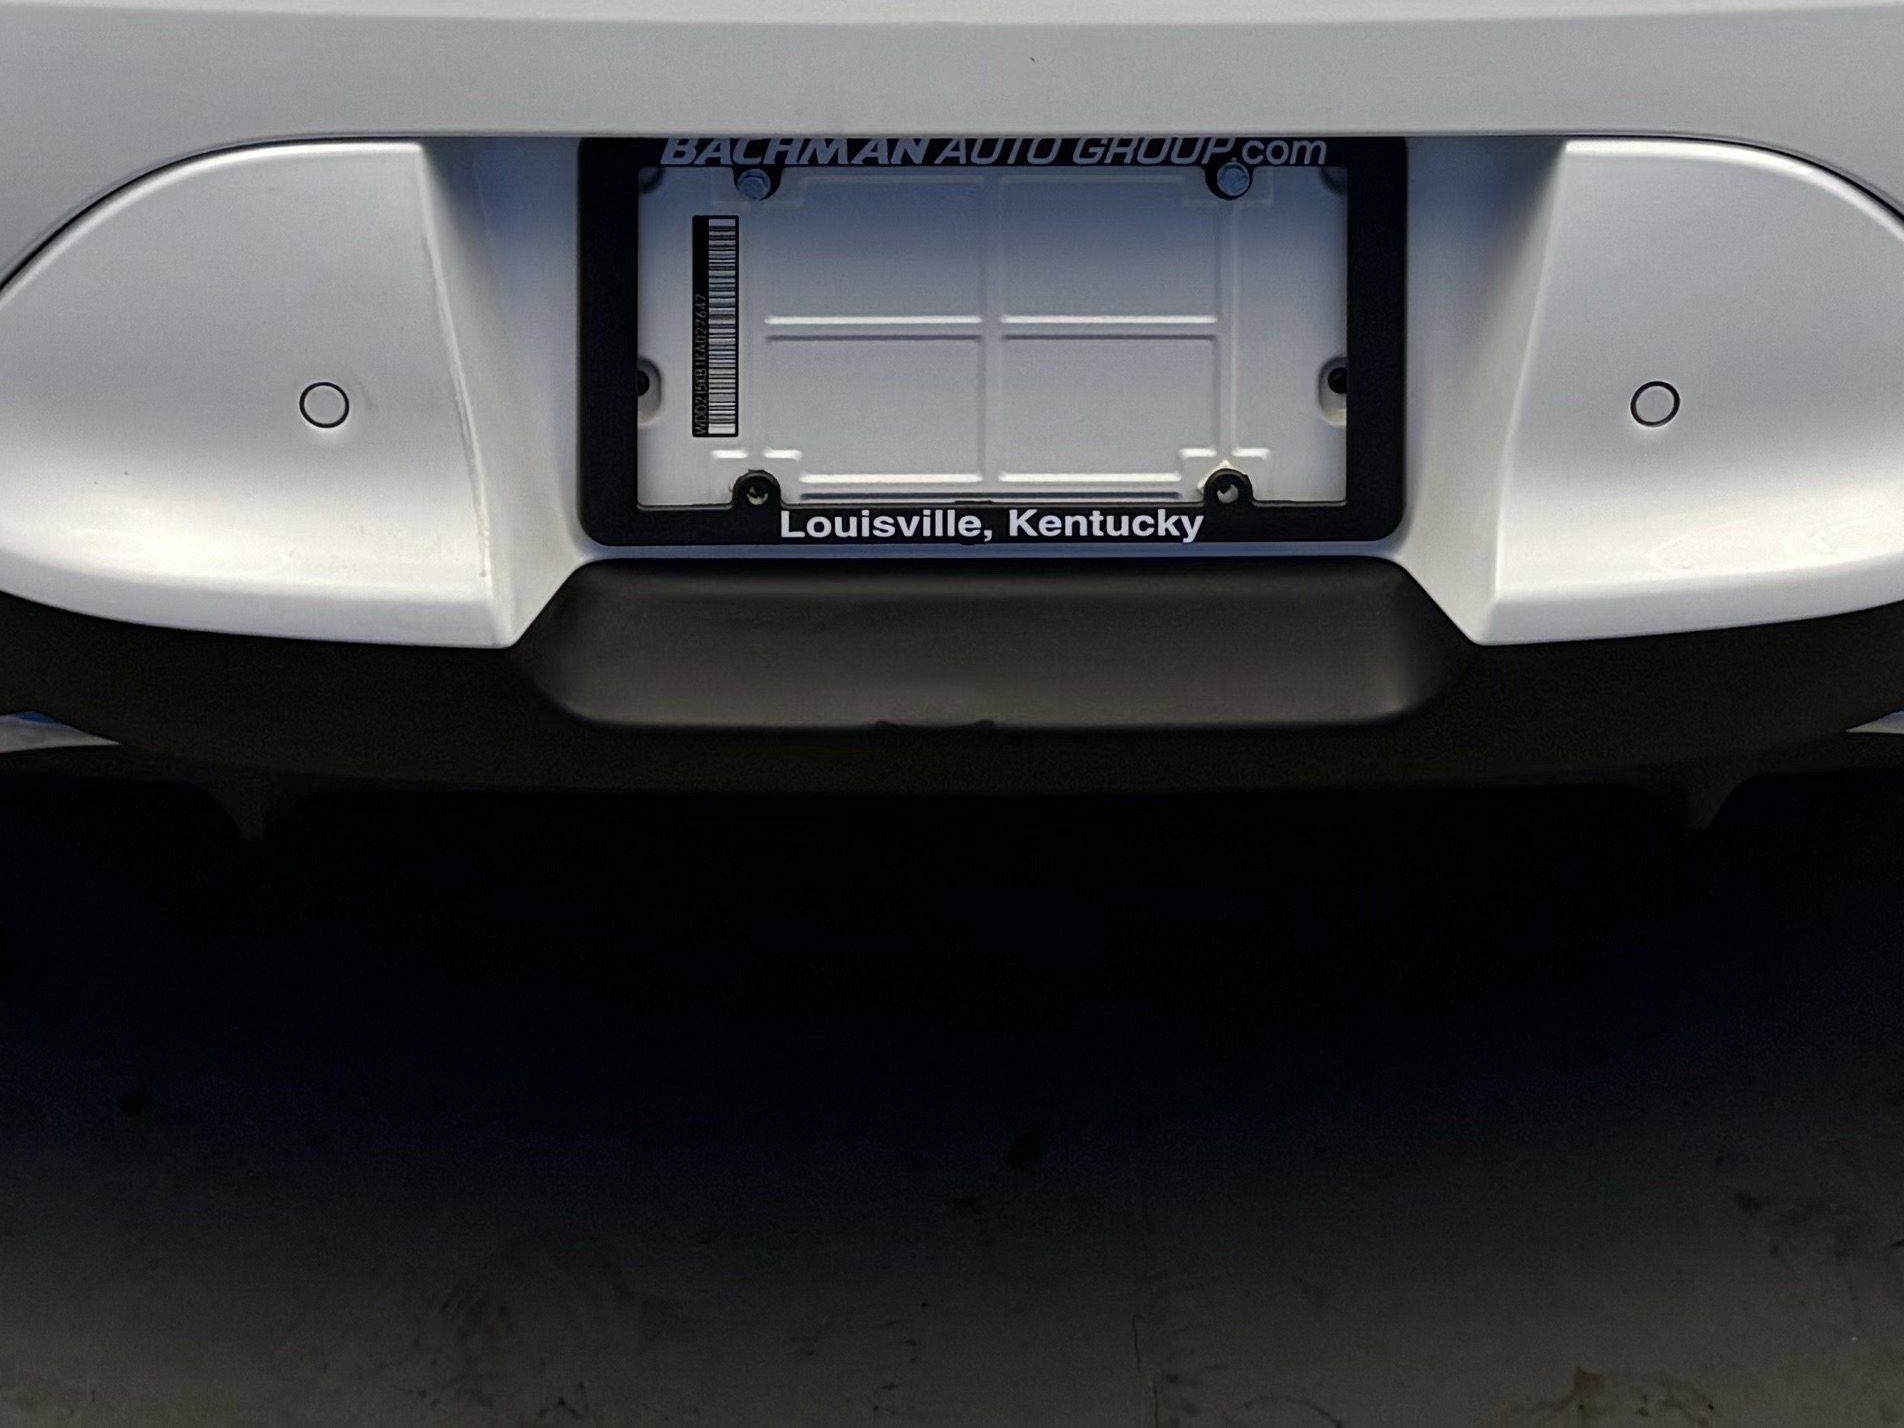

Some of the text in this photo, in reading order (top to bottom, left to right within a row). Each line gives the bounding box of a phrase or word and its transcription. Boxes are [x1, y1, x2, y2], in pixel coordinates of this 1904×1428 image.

[660, 137, 933, 165] BACHMAN
[936, 137, 1062, 165] AUTO
[780, 508, 1205, 543] Louisville, Kentucky
